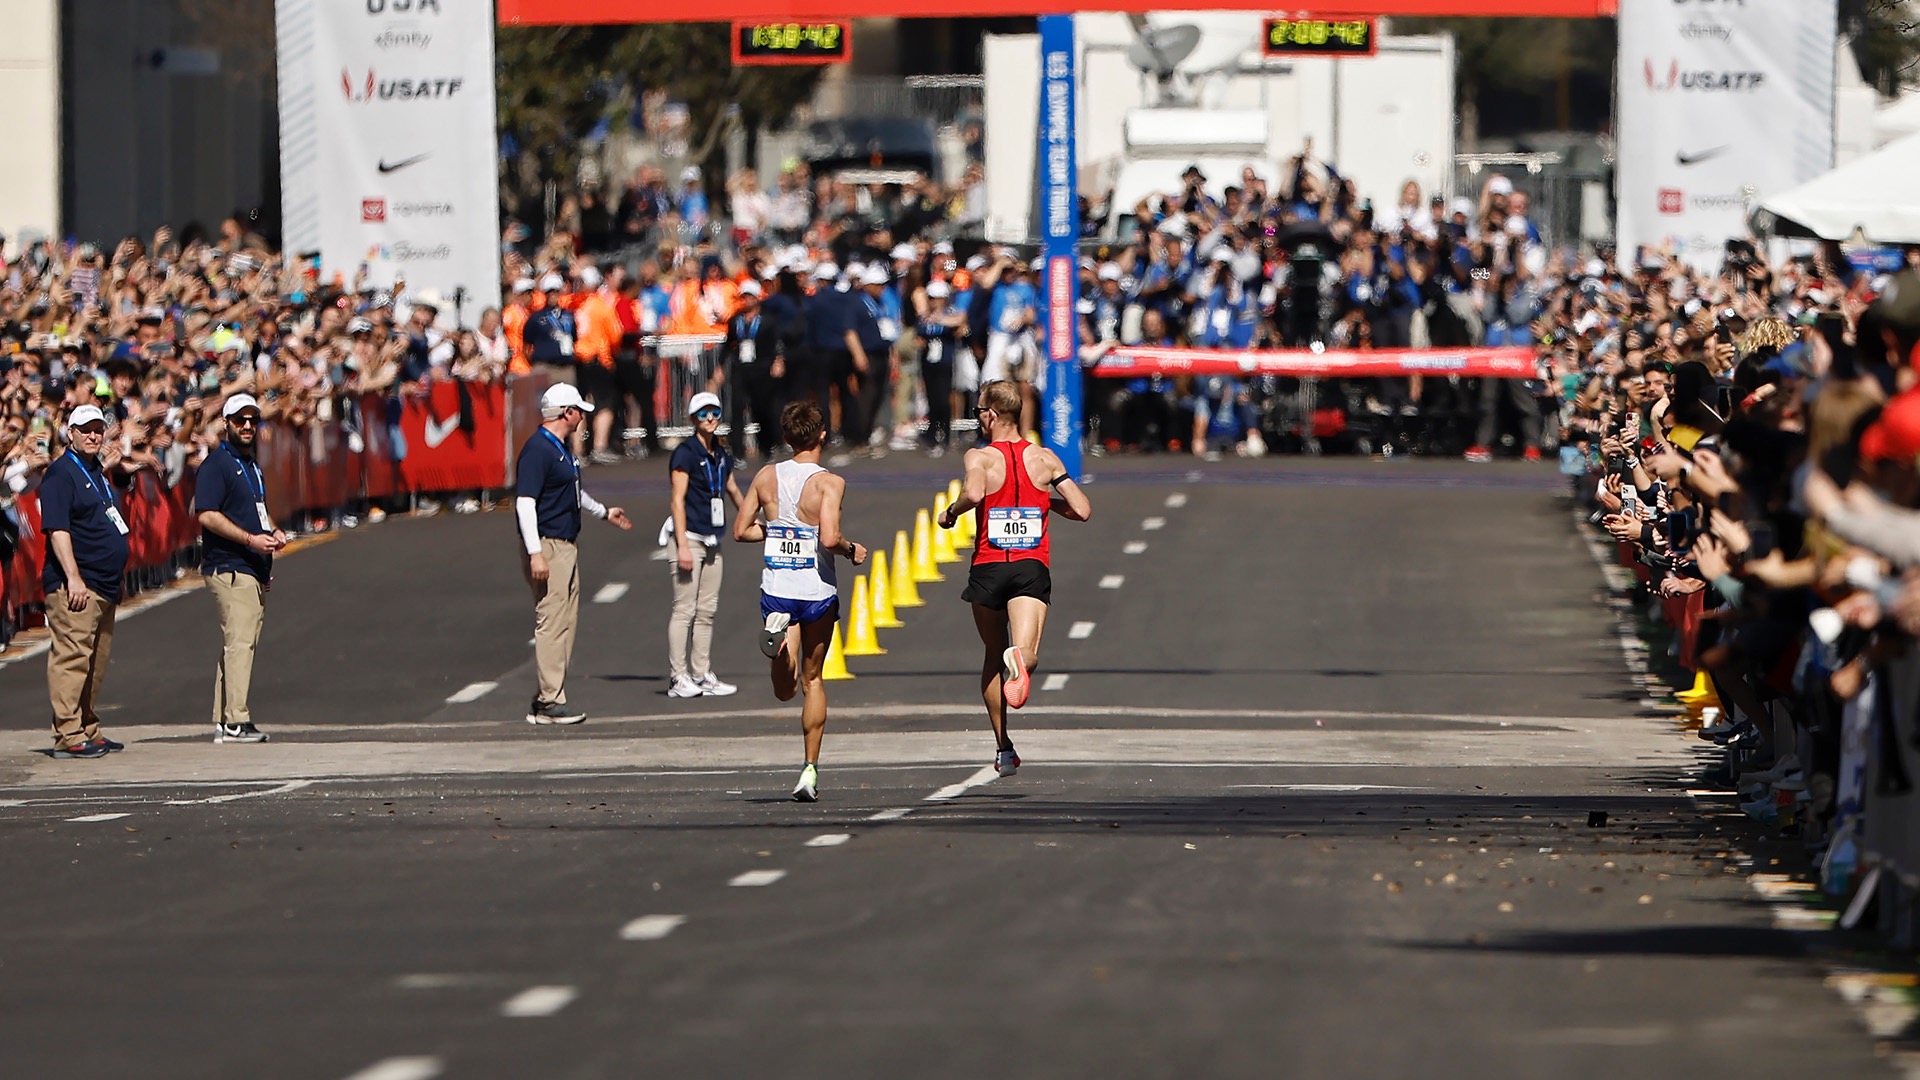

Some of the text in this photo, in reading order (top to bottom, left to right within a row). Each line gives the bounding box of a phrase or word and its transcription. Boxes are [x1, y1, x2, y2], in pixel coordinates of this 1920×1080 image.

[379, 78, 462, 99] USATF
[1680, 71, 1764, 91] USATF
[1003, 522, 1027, 535] 405
[780, 541, 801, 555] 404
